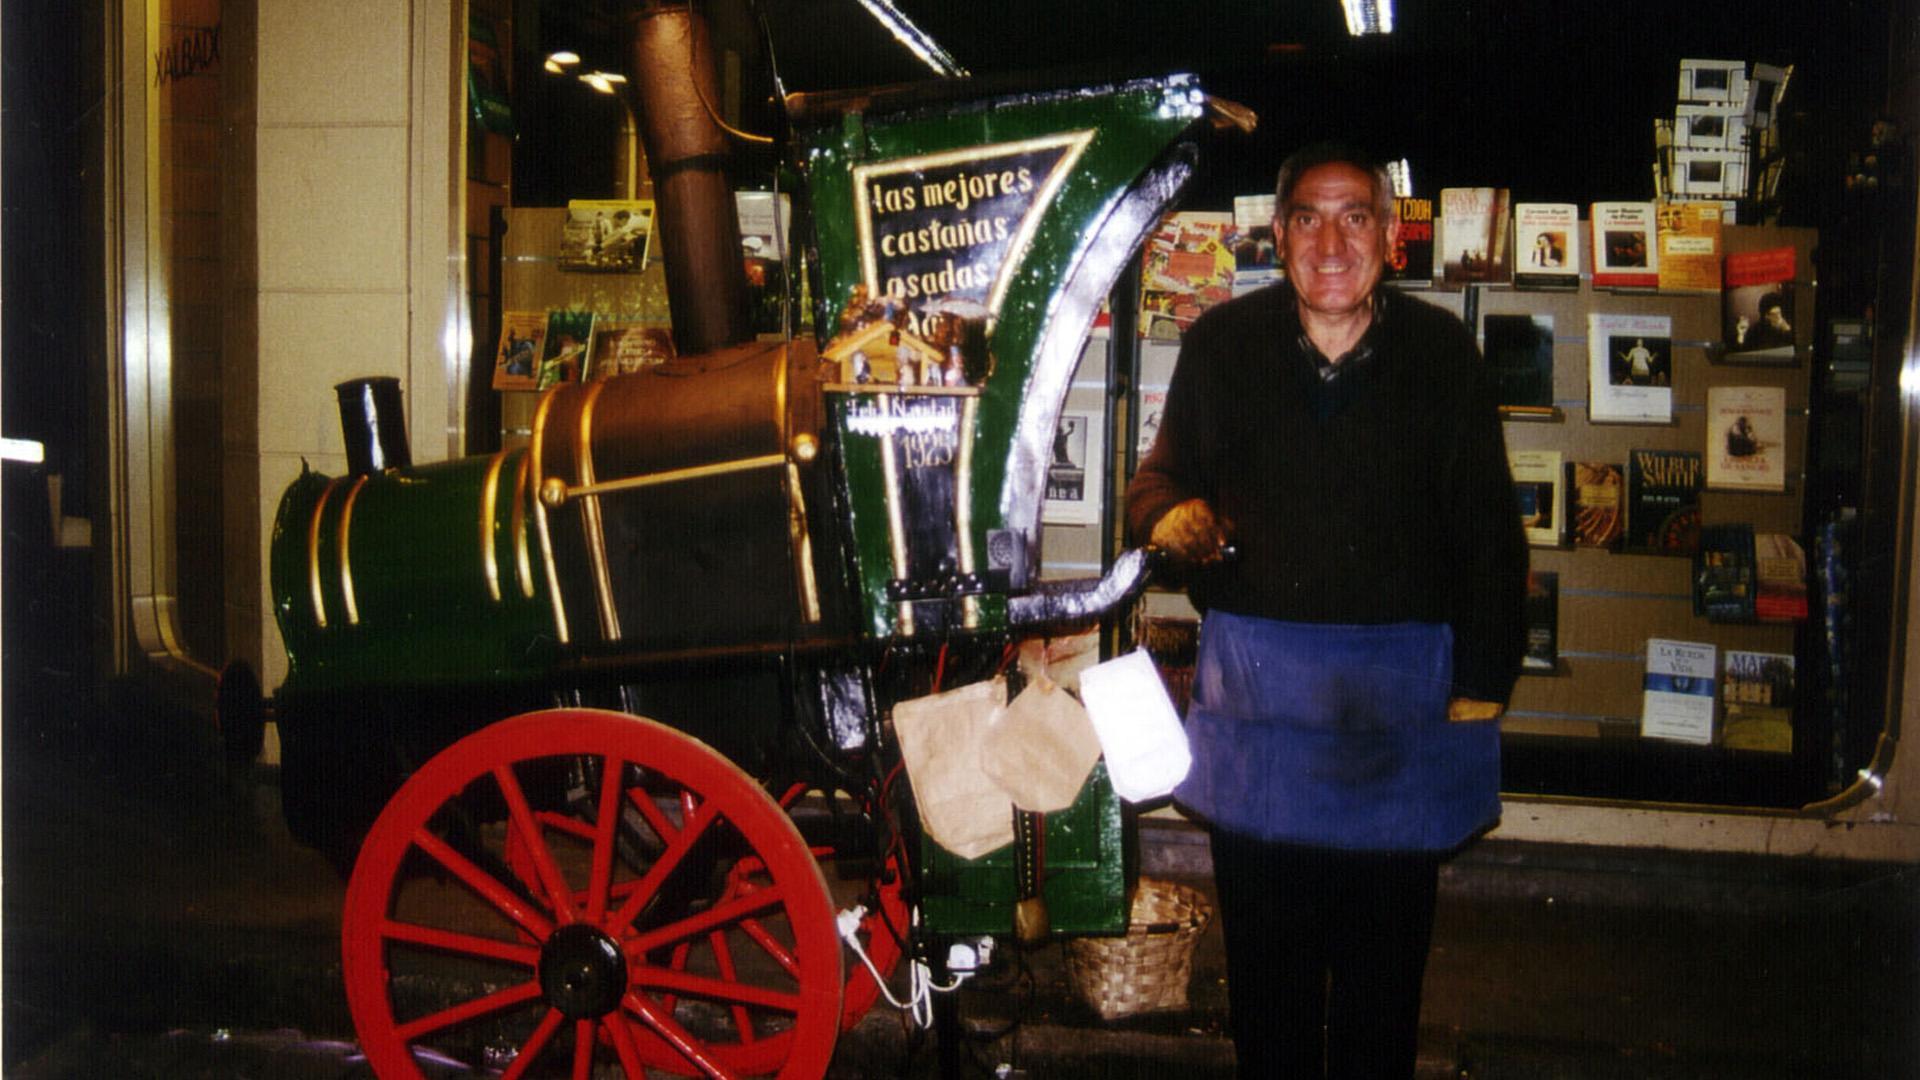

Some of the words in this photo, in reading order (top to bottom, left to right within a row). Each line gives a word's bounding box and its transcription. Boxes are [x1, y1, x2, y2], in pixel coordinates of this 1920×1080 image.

[873, 183, 915, 213] las
[923, 166, 1033, 210] mejores
[881, 216, 1008, 257] castañas
[886, 260, 991, 298] asadas
